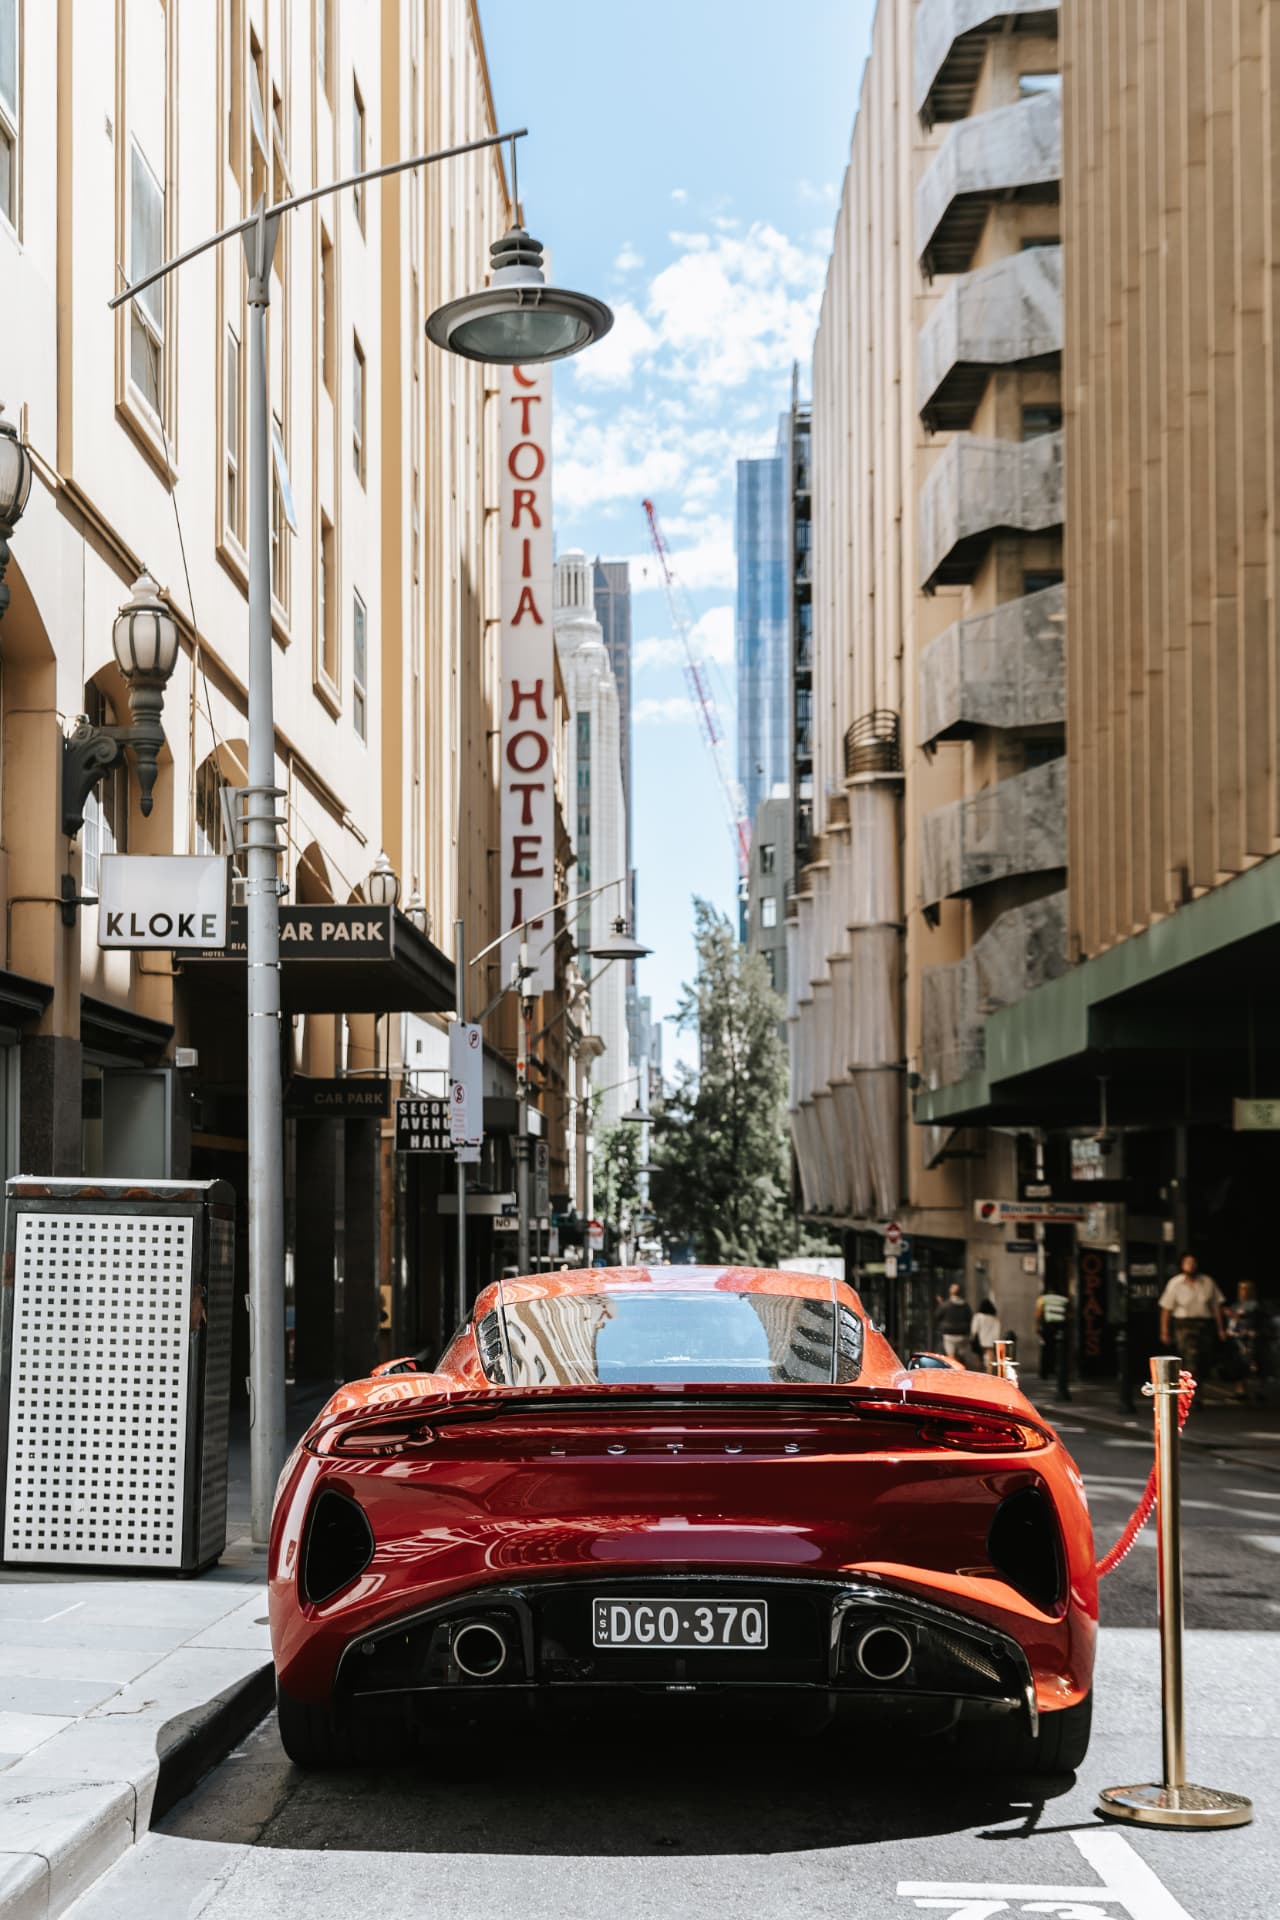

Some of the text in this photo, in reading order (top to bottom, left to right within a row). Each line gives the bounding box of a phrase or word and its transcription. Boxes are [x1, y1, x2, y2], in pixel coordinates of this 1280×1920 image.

[506, 365, 549, 930] CTORIA HOTEL
[106, 912, 217, 937] KLOKE
[277, 921, 384, 941] AR PARK
[314, 1092, 384, 1104] CAR PARK
[399, 1102, 451, 1116] SECON
[401, 1117, 451, 1130] AVENU
[410, 1135, 452, 1149] HAIR
[495, 1218, 511, 1227] NO
[550, 1443, 801, 1457] LOTUS
[598, 1607, 609, 1640] NSW
